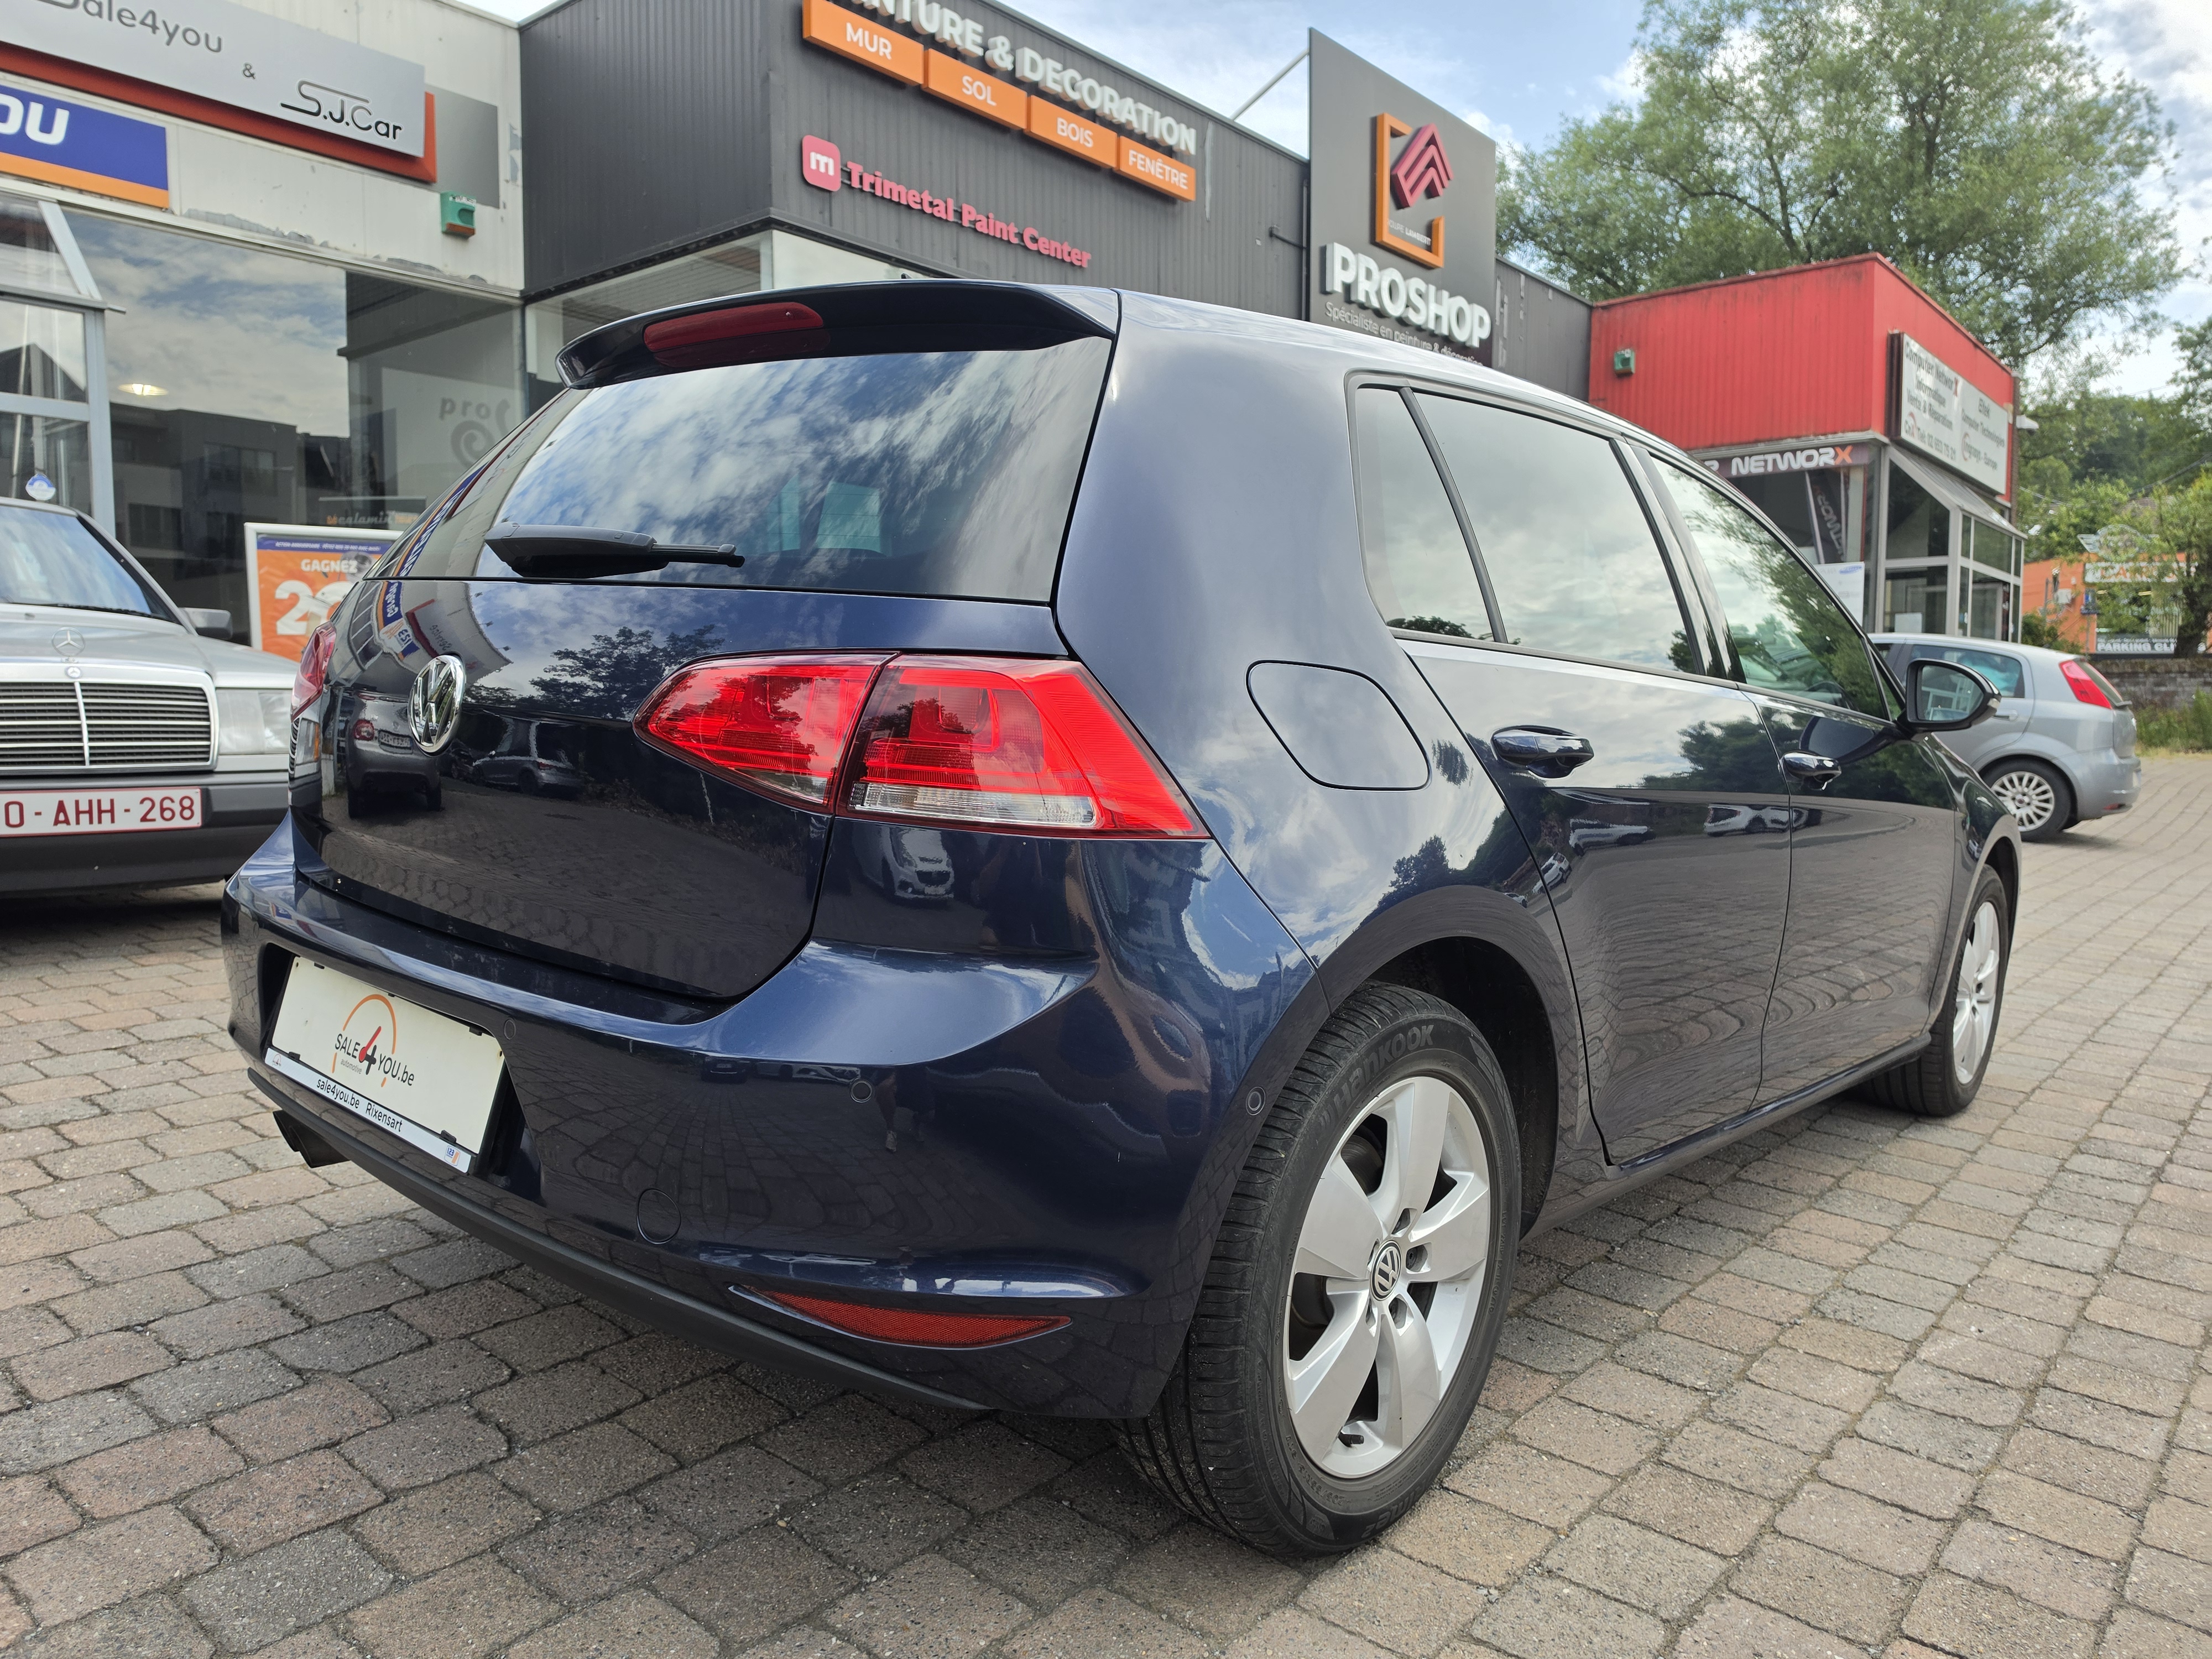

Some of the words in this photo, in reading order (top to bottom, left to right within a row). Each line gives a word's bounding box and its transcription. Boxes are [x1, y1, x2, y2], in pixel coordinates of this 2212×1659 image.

[35, 0, 222, 53] ale4you
[846, 22, 892, 60] MUR
[242, 62, 255, 80] &
[962, 75, 997, 106] SOL
[985, 36, 1014, 71] &
[1016, 47, 1196, 155] DECORATION
[1056, 117, 1094, 148] BOIS
[1129, 149, 1189, 190] FENÊTRE
[846, 160, 954, 222] Trimetal
[961, 202, 1020, 244] Paint
[1022, 226, 1092, 268] Center
[1326, 242, 1491, 348] PROSHOP
[1905, 342, 1934, 376] Computer
[1731, 445, 1853, 476] NETWORX
[300, 558, 358, 573] GAGNEZ
[2097, 643, 2152, 652] PARKING
[340, 1058, 363, 1074] automotive
[316, 1078, 360, 1109] sale4you.be
[366, 1102, 403, 1132] Rixensart
